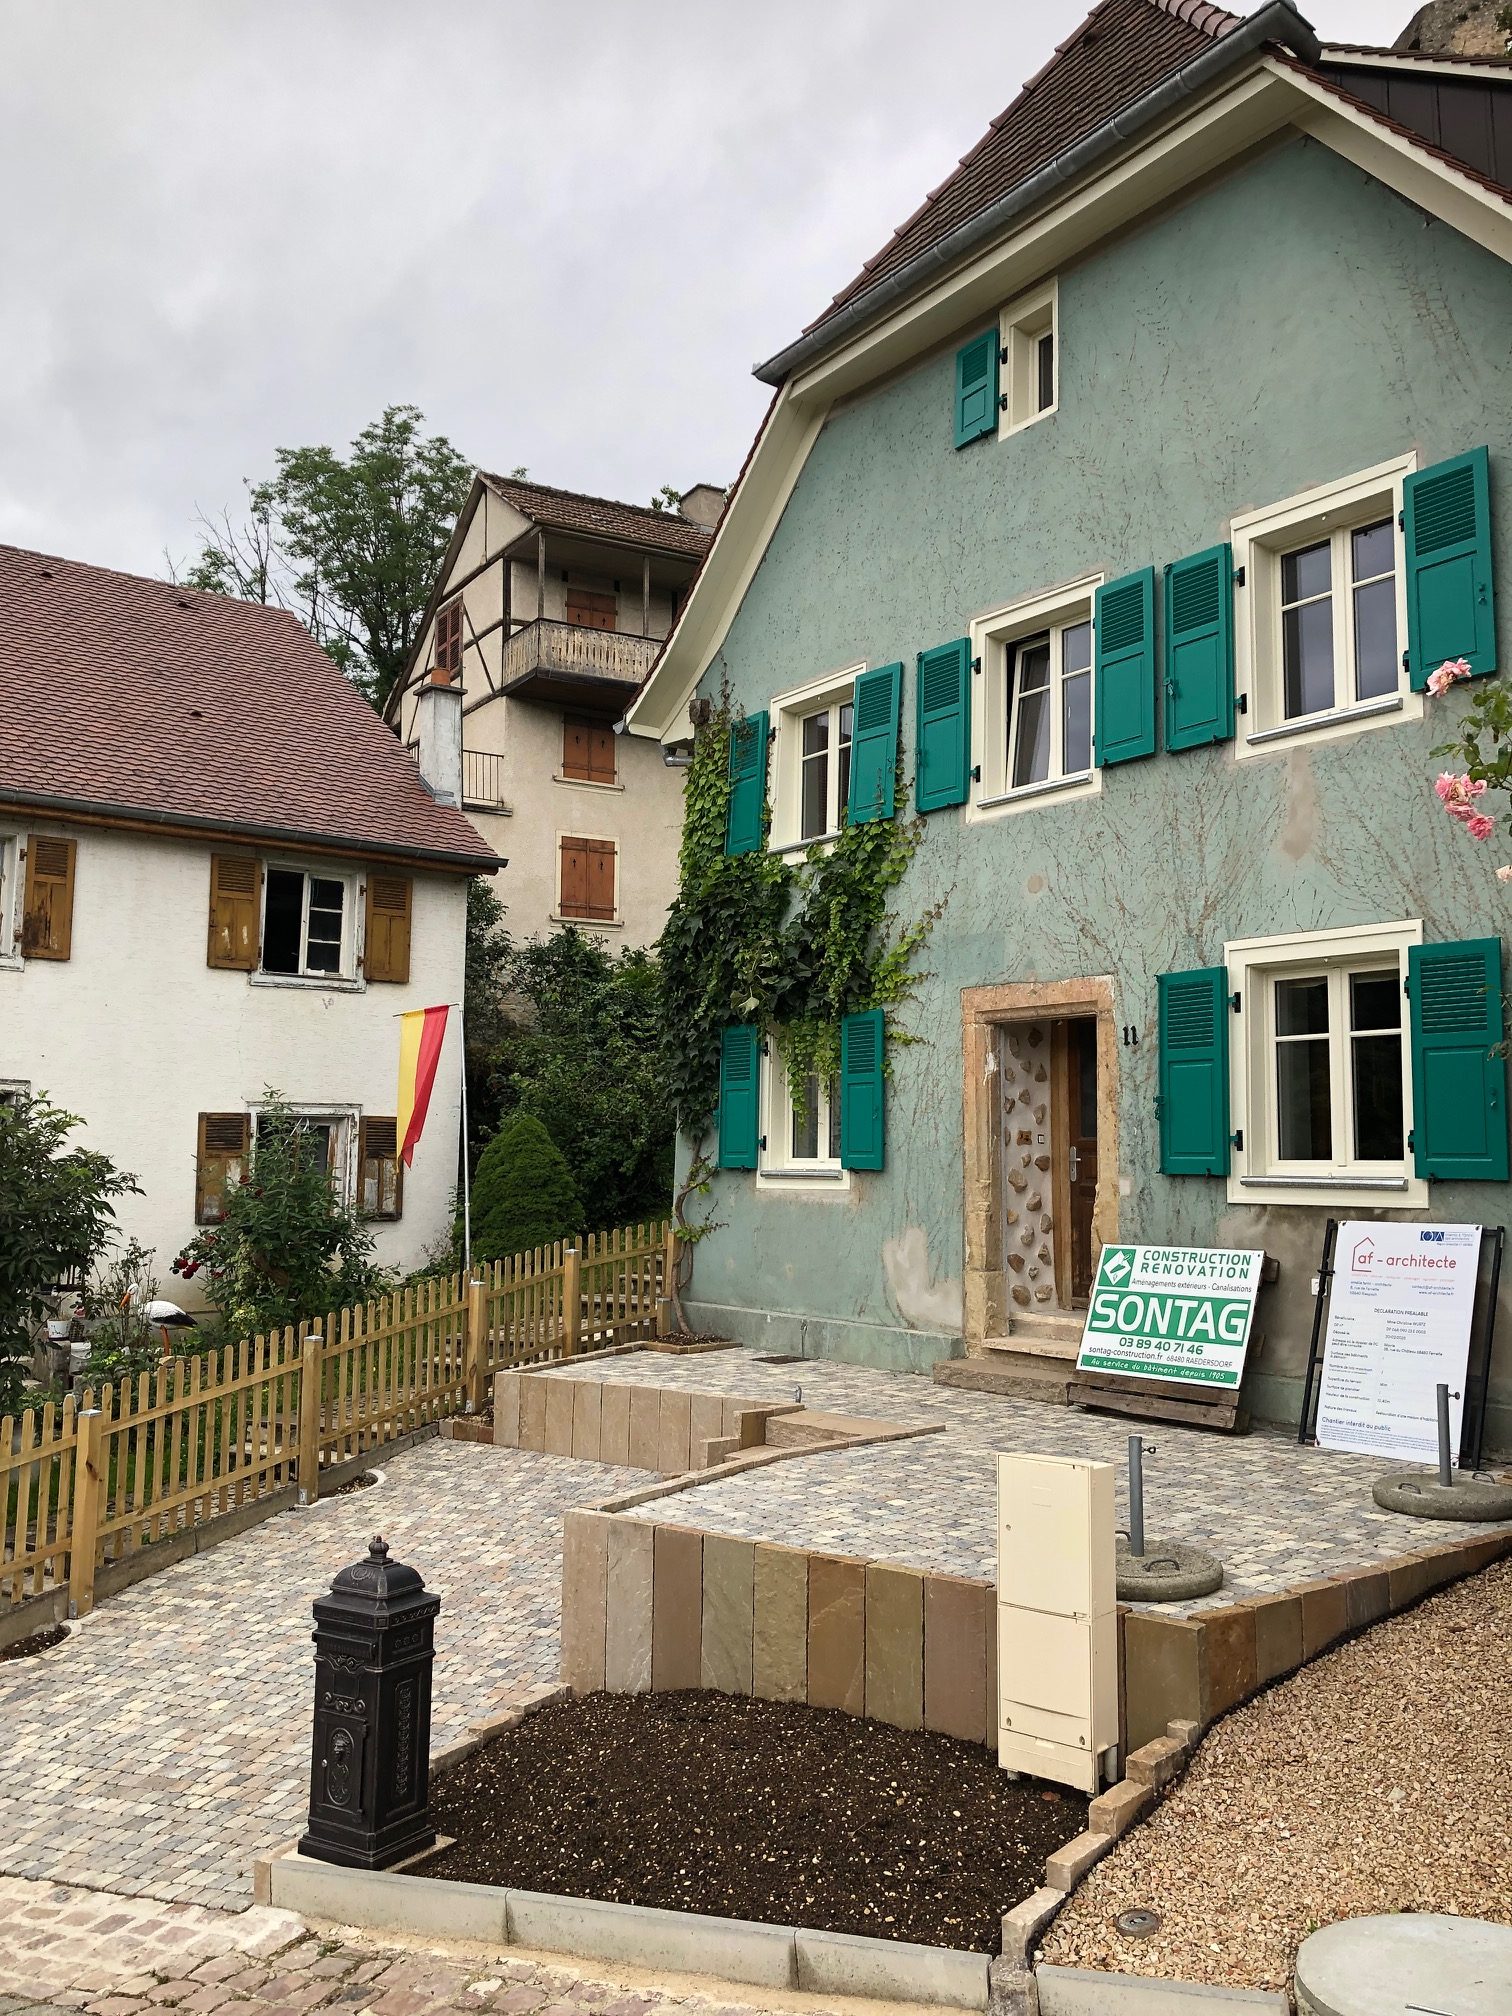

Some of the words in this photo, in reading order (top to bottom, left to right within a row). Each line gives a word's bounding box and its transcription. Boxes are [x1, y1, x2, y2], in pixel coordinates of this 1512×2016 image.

[1122, 1025, 1139, 1046] 11
[1143, 1250, 1252, 1266] CONSTRUCTION
[1358, 1251, 1374, 1265] af
[1386, 1254, 1457, 1269] architecte
[1140, 1262, 1250, 1279] RENOVATION
[1131, 1278, 1177, 1289] Aménagements
[1177, 1280, 1207, 1290] extérieurs
[1212, 1283, 1252, 1293] Canalisations
[1091, 1293, 1249, 1342] SONTAG
[1119, 1337, 1133, 1348] 03
[1136, 1339, 1152, 1349] 89
[1154, 1341, 1171, 1352] 40
[1174, 1343, 1184, 1354] 71
[1187, 1344, 1204, 1355] 46
[1088, 1346, 1164, 1361] sontag-construction.fr
[1166, 1355, 1185, 1363] 68480
[1186, 1356, 1233, 1368] RAEDERSDORF
[1090, 1357, 1100, 1366] Au
[1103, 1359, 1129, 1369] service
[1143, 1363, 1178, 1375] bâtiment
[1180, 1367, 1206, 1379] depuis
[1208, 1371, 1225, 1380] 1905
[1321, 1417, 1345, 1425] Chantier
[1346, 1419, 1366, 1428] interdit
[1374, 1423, 1391, 1432] public
